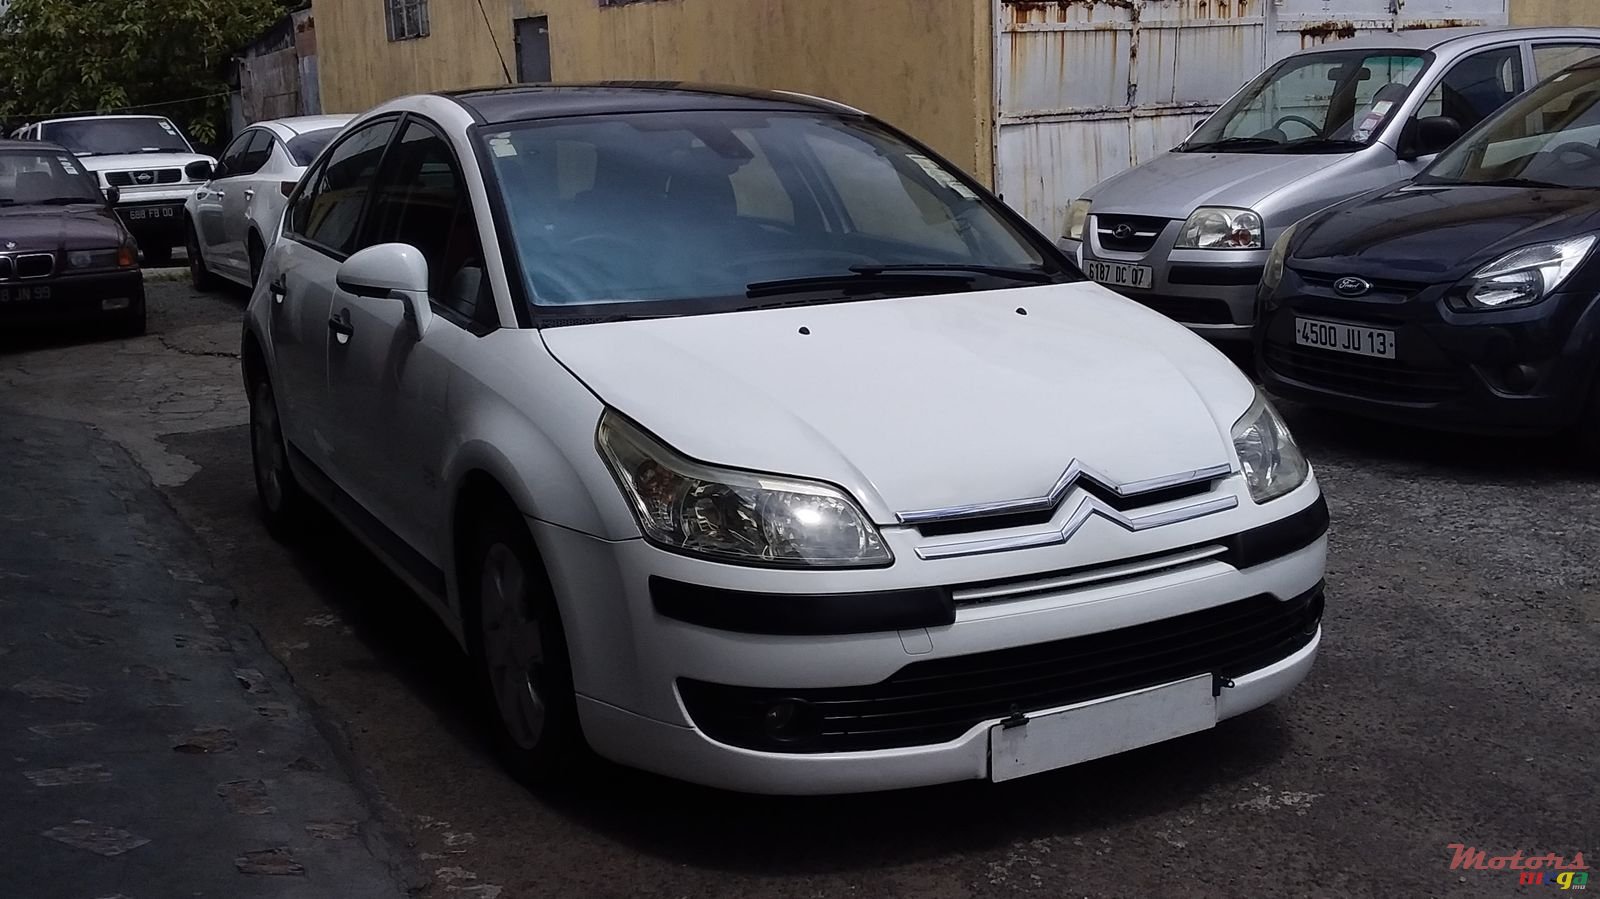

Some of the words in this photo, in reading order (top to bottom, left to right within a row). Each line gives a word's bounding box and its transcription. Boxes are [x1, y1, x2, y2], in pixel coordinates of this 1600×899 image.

[1089, 262, 1110, 281] 6187
[1116, 266, 1126, 283] DC
[1131, 268, 1144, 285] 07
[1302, 321, 1337, 347] 4500
[1342, 328, 1361, 351] JU
[1367, 331, 1386, 354] 13
